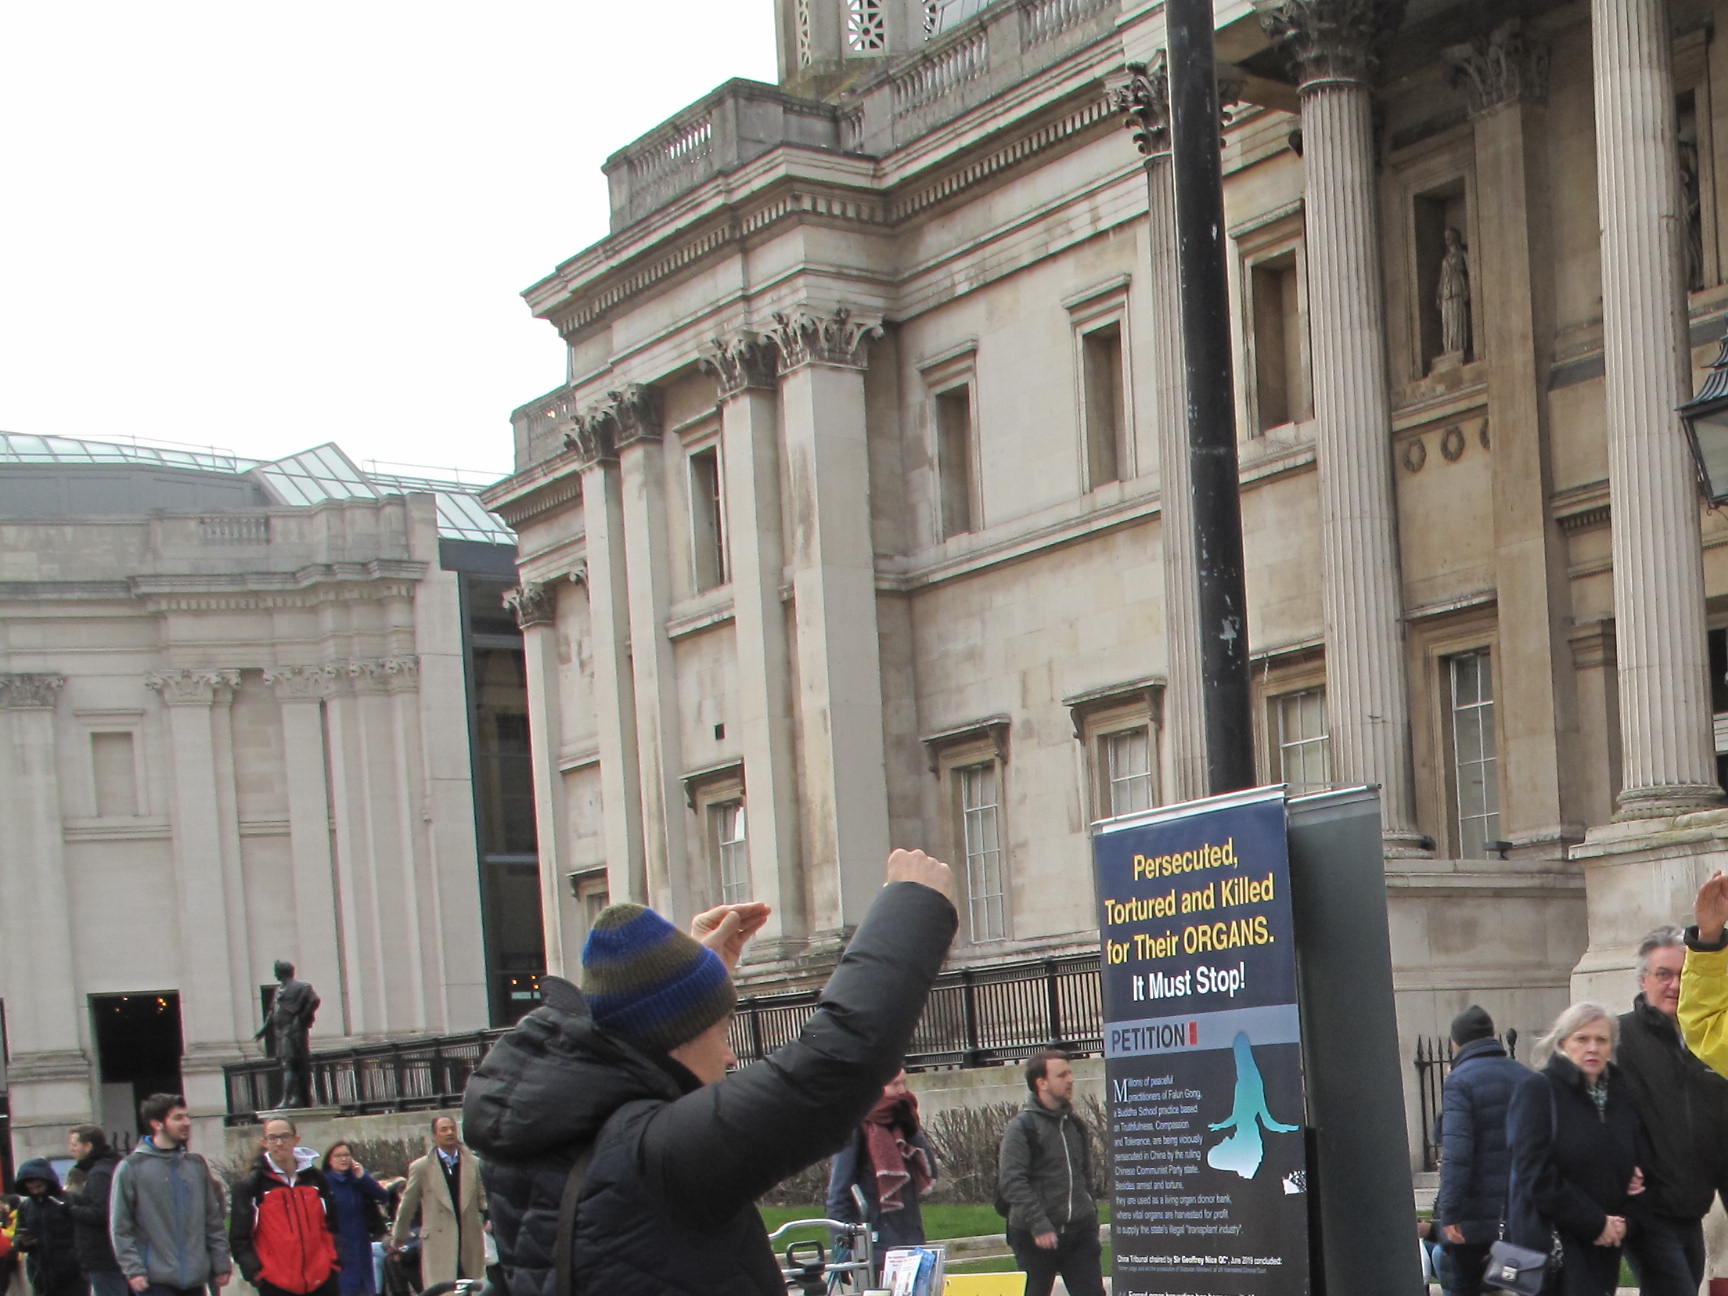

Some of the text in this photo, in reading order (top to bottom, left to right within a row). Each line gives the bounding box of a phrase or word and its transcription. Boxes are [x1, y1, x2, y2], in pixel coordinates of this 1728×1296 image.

[1133, 837, 1238, 880] Persecuted,
[1105, 873, 1274, 925] Tortured and Killed
[1106, 916, 1274, 964] for Their ORGANS.
[1133, 962, 1245, 1000] It Must Stop!
[1111, 1023, 1185, 1052] PETITION
